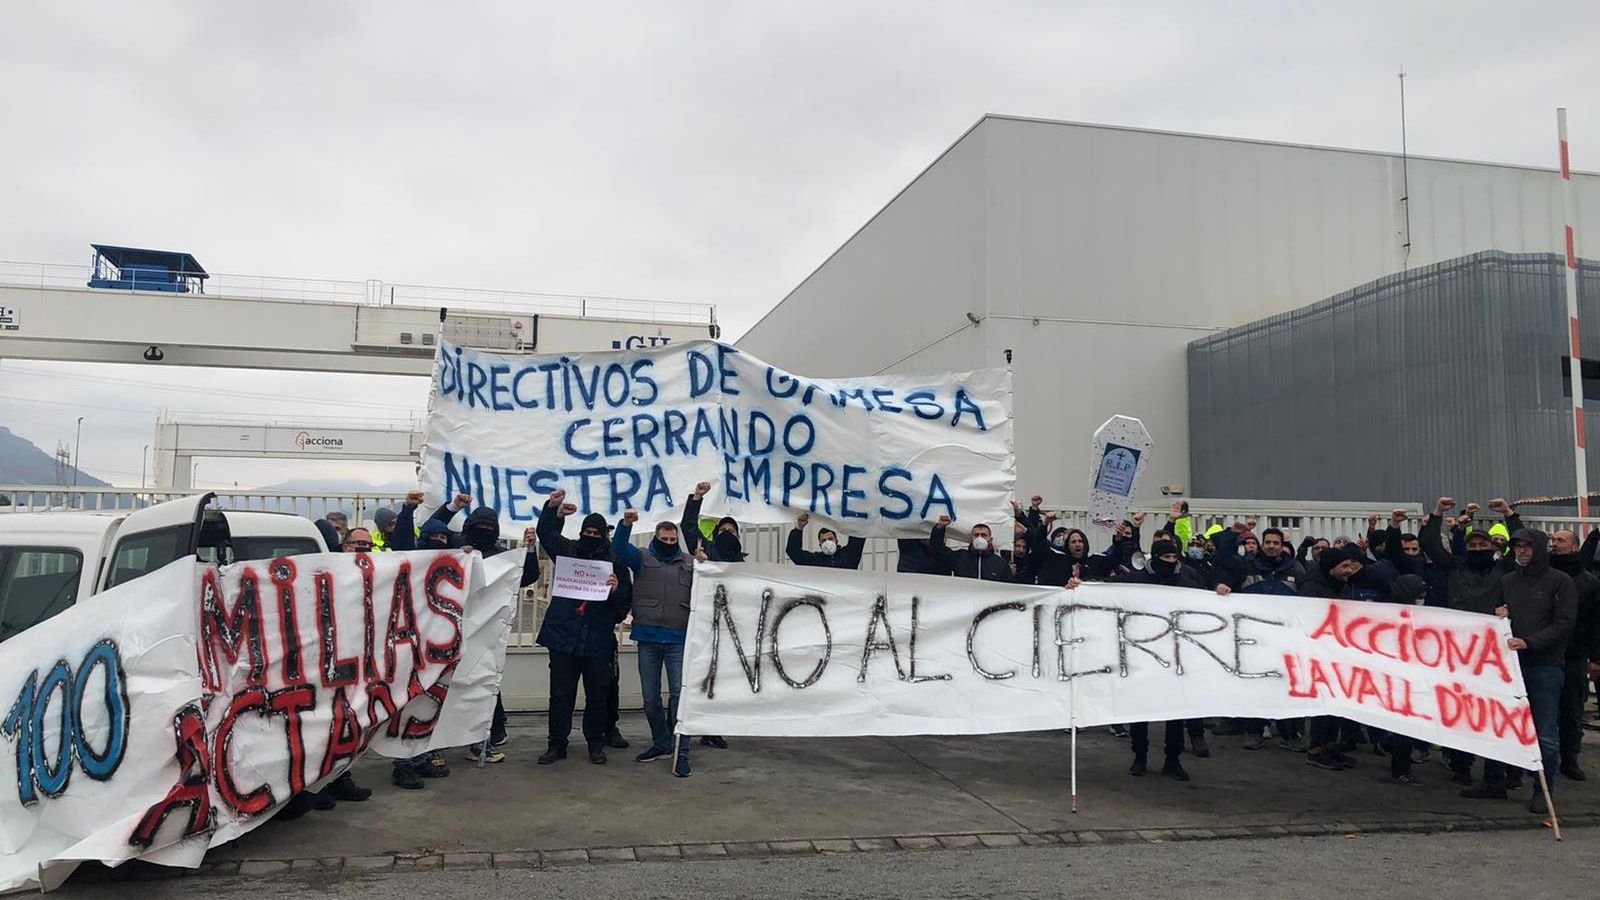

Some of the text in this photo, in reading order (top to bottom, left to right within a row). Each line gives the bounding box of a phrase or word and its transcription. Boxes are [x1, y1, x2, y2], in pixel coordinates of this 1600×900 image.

[688, 343, 740, 399] DE
[305, 436, 343, 446] acciona
[564, 407, 815, 460] CERRANDO
[444, 452, 957, 520] NUESTRA EMPRESA
[574, 569, 585, 577] NO
[700, 583, 1285, 699] NO AL CIERRE
[2, 637, 131, 807] 100
